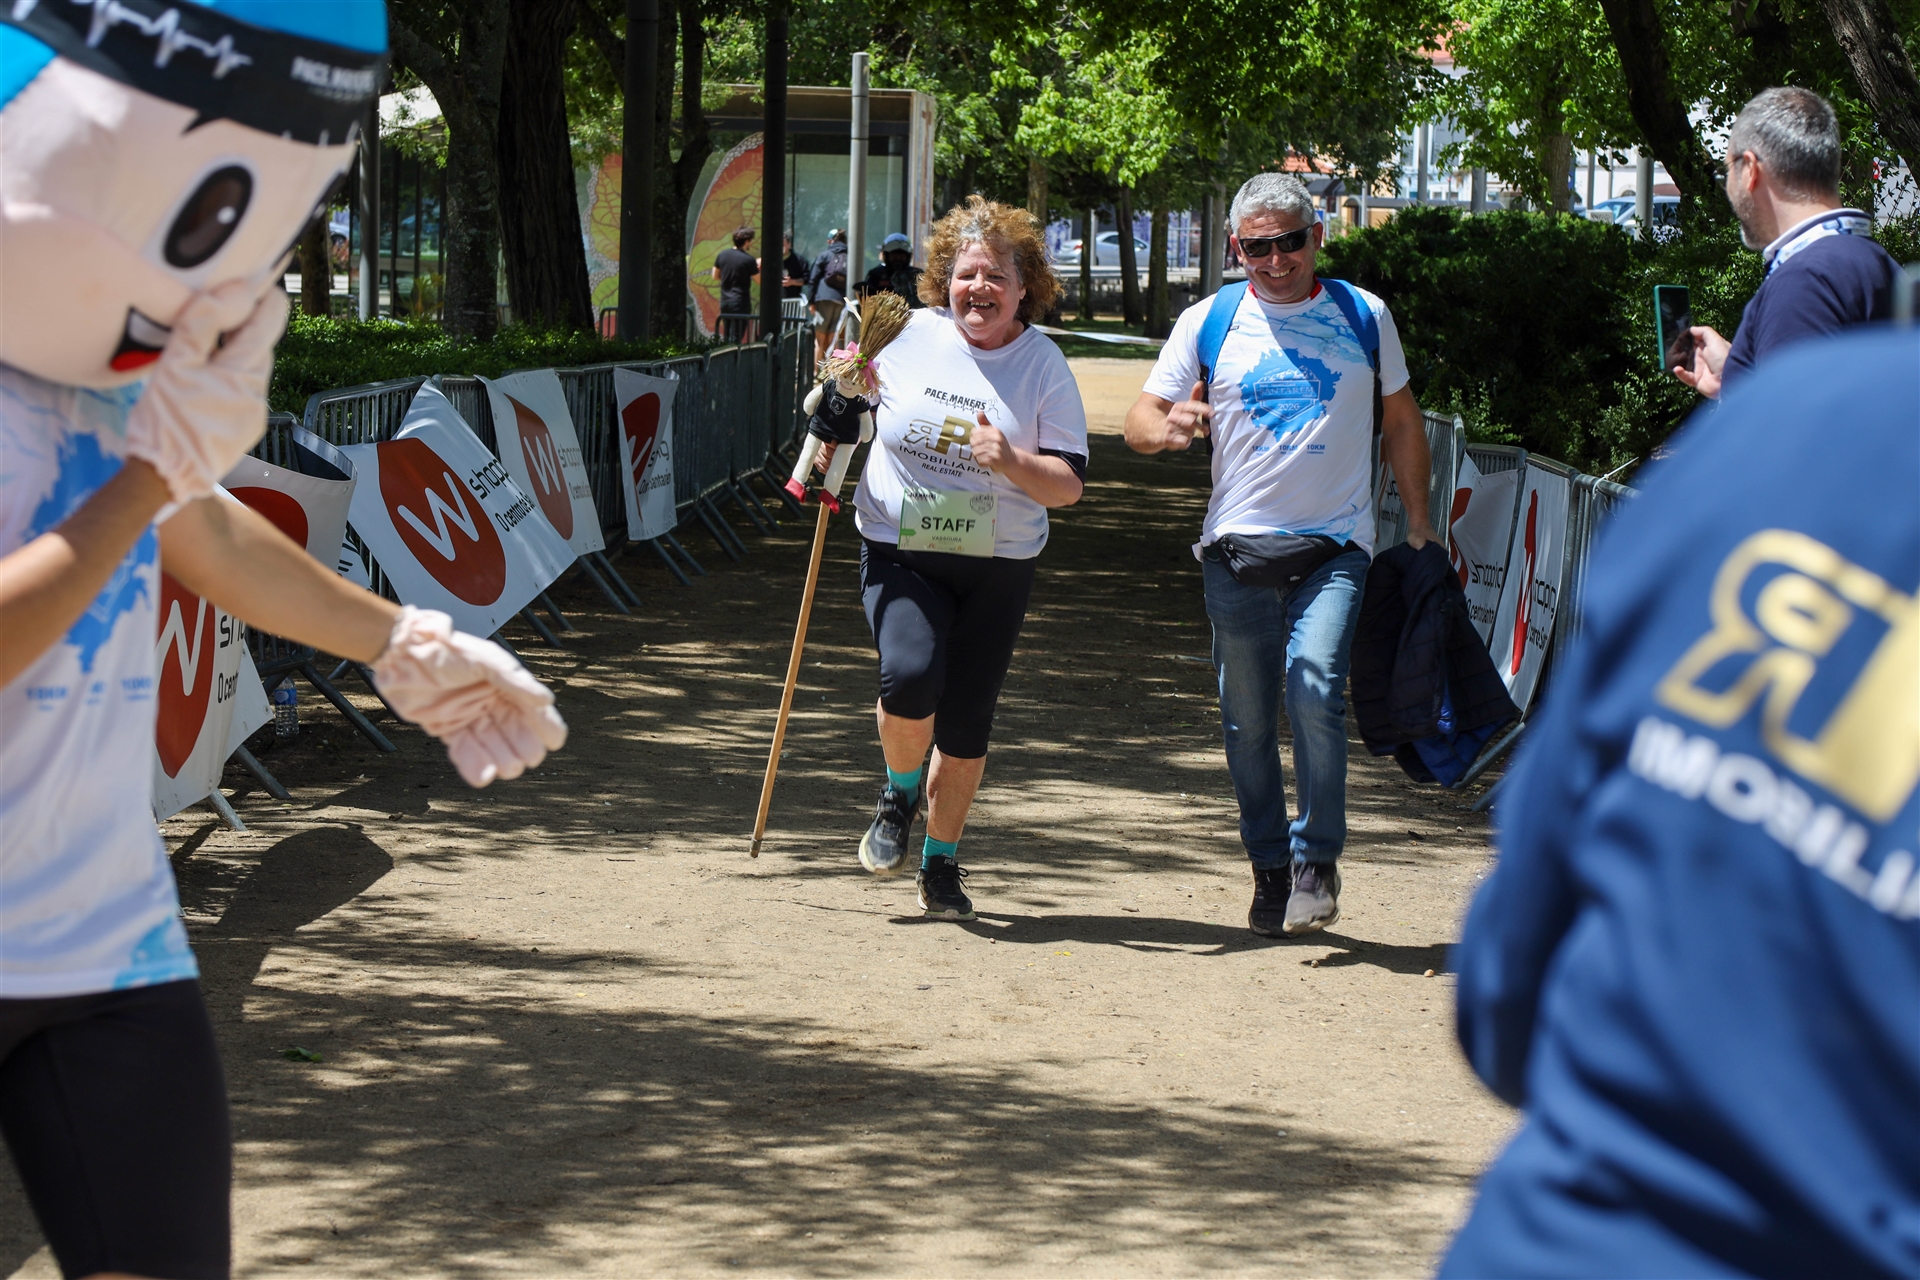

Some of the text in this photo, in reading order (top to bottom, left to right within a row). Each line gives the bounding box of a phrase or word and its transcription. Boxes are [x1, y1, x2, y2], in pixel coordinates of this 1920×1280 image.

[924, 387, 987, 411] PACE MAKERS
[1278, 403, 1300, 411] 2026
[899, 445, 991, 477] IMOBILIÁRIA
[921, 462, 963, 478] REAL ESTATE
[921, 516, 976, 534] STAFF
